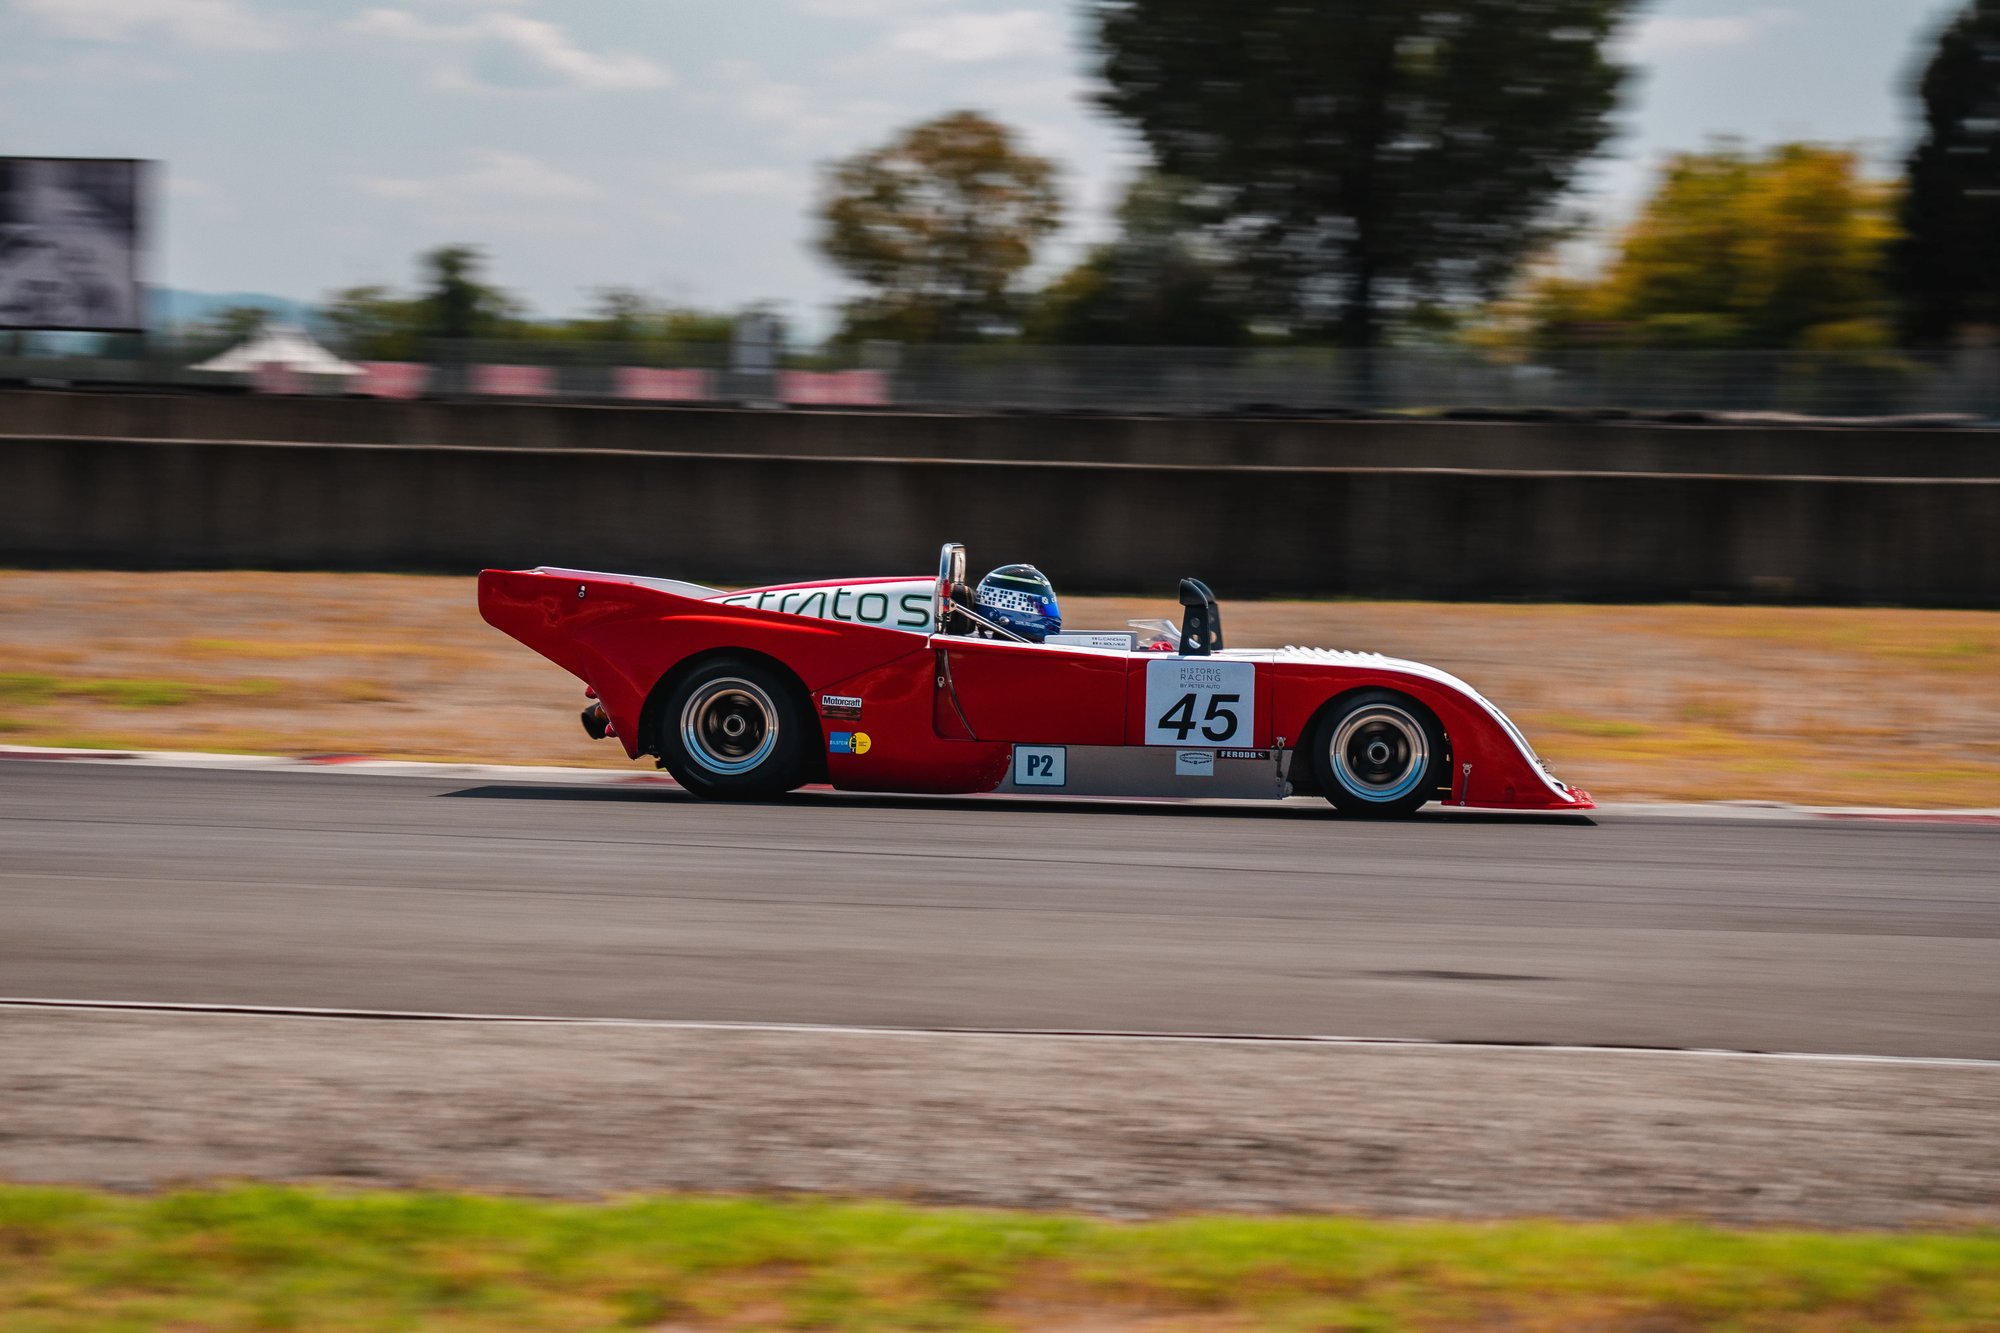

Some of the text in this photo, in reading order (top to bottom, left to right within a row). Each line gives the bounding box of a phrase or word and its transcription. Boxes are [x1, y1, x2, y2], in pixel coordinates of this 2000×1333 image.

[1180, 667, 1221, 675] HISTORIC
[1180, 674, 1221, 682] RACING
[823, 697, 861, 706] Motorcraft
[1157, 693, 1241, 742] 45
[1220, 750, 1257, 759] FERODO
[1027, 754, 1054, 777] P2
